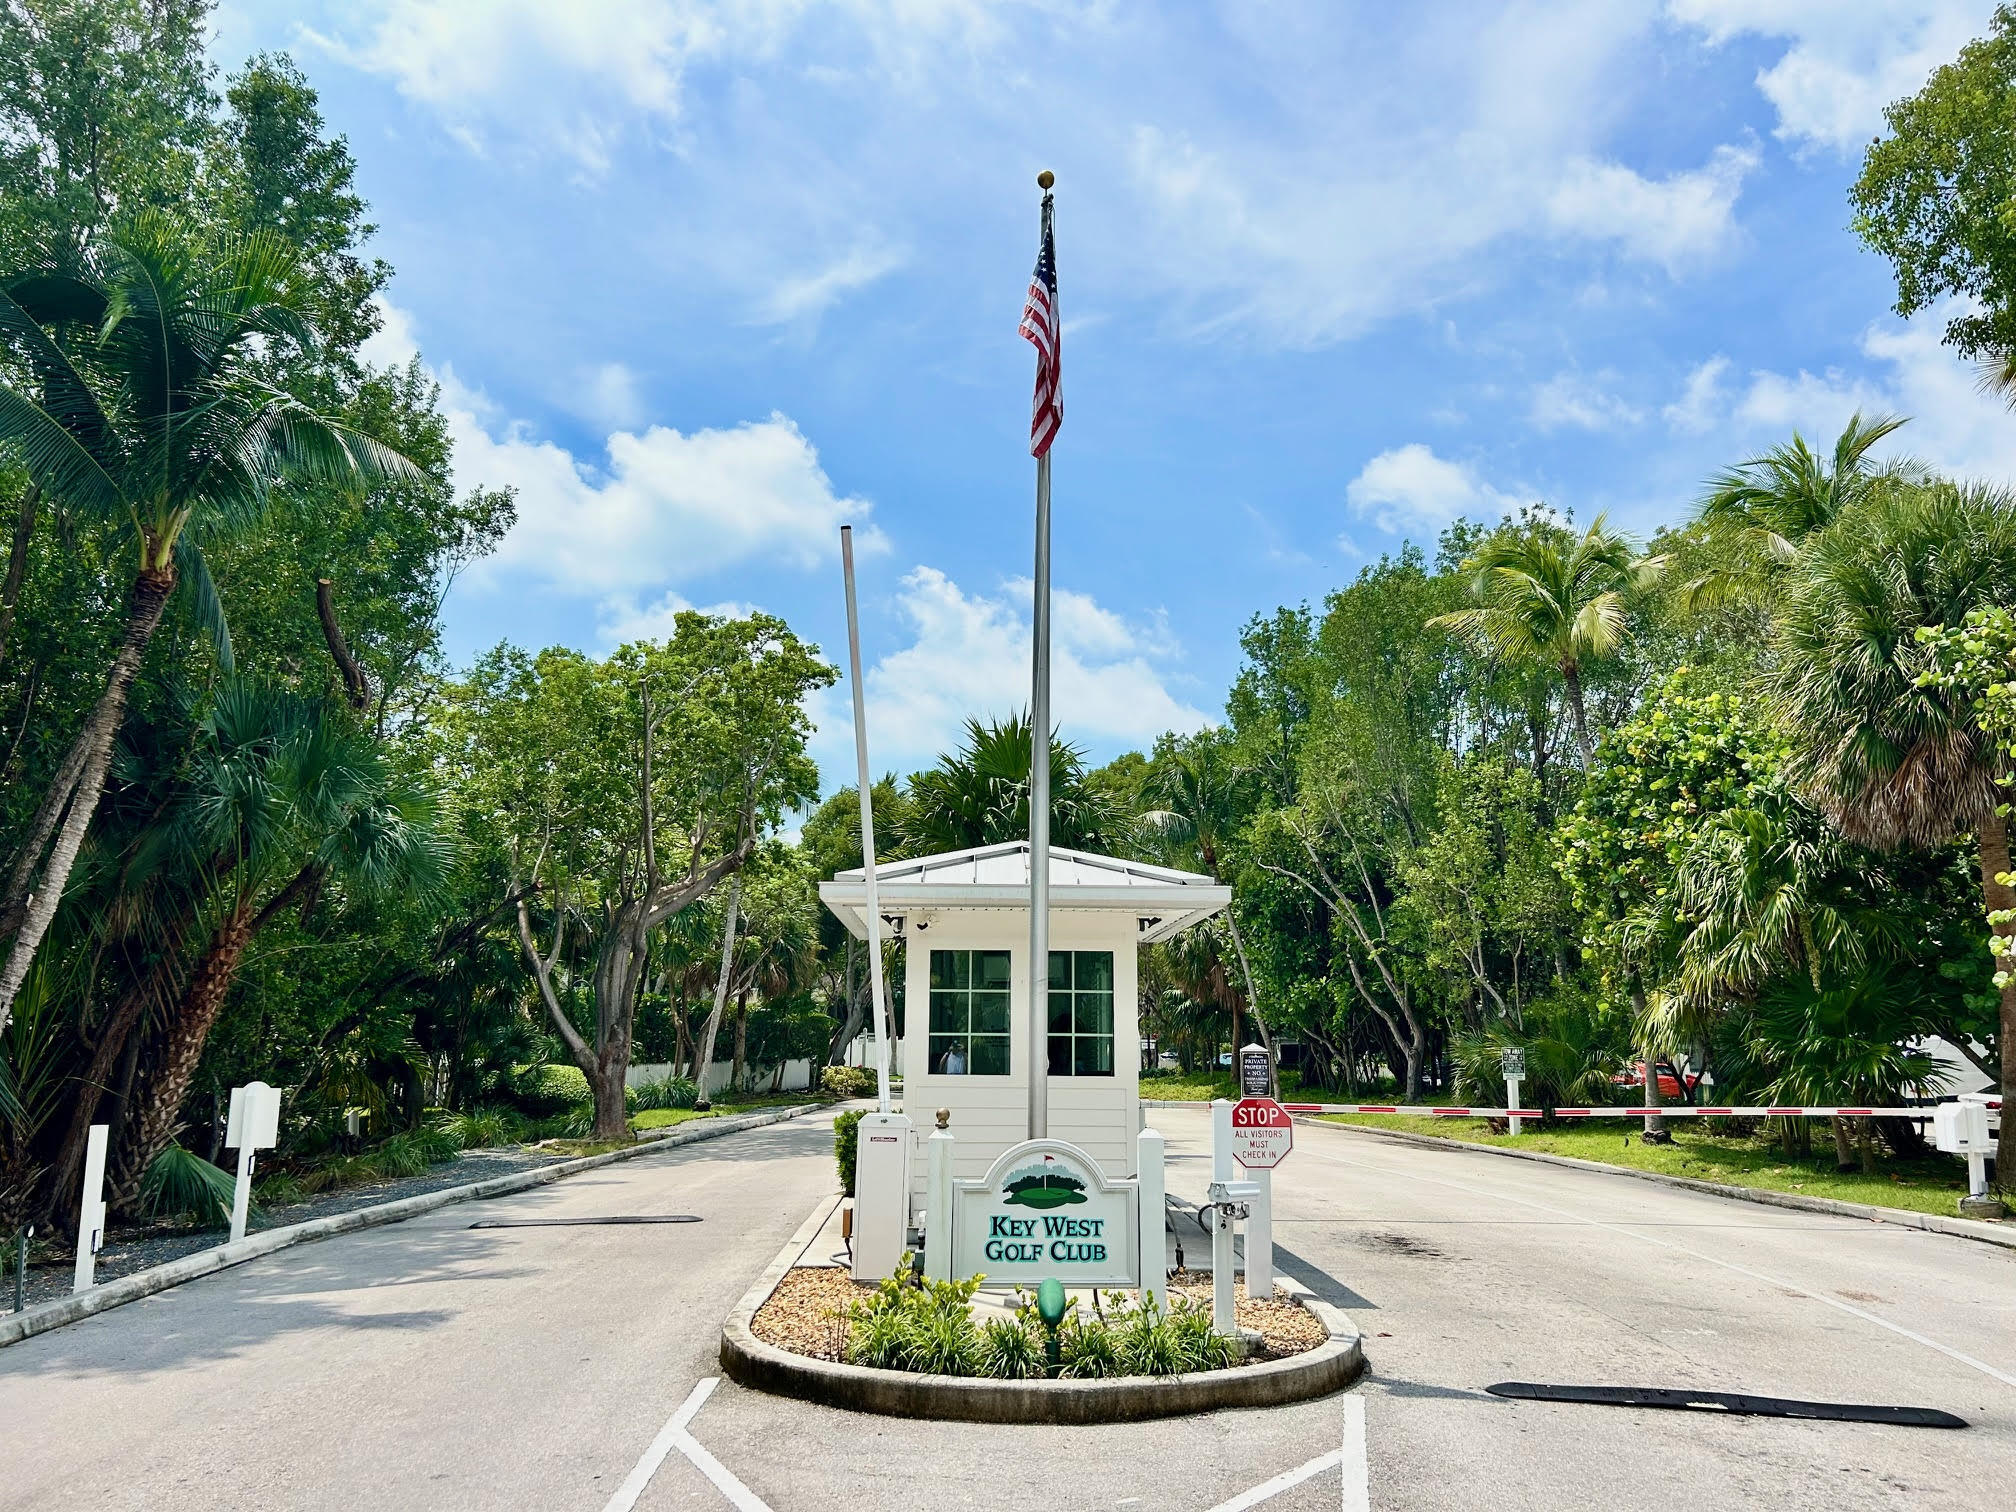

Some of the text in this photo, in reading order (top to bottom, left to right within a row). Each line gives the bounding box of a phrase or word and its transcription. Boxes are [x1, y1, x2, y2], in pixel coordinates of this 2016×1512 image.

[1238, 1107, 1279, 1125] STOP
[1235, 1130, 1282, 1138] ALL VISITORS
[1249, 1140, 1269, 1148] MUST
[1242, 1150, 1277, 1159] CHECK IN
[990, 1215, 1105, 1237] KEY WEST
[984, 1239, 1107, 1262] GOLF CLUB
